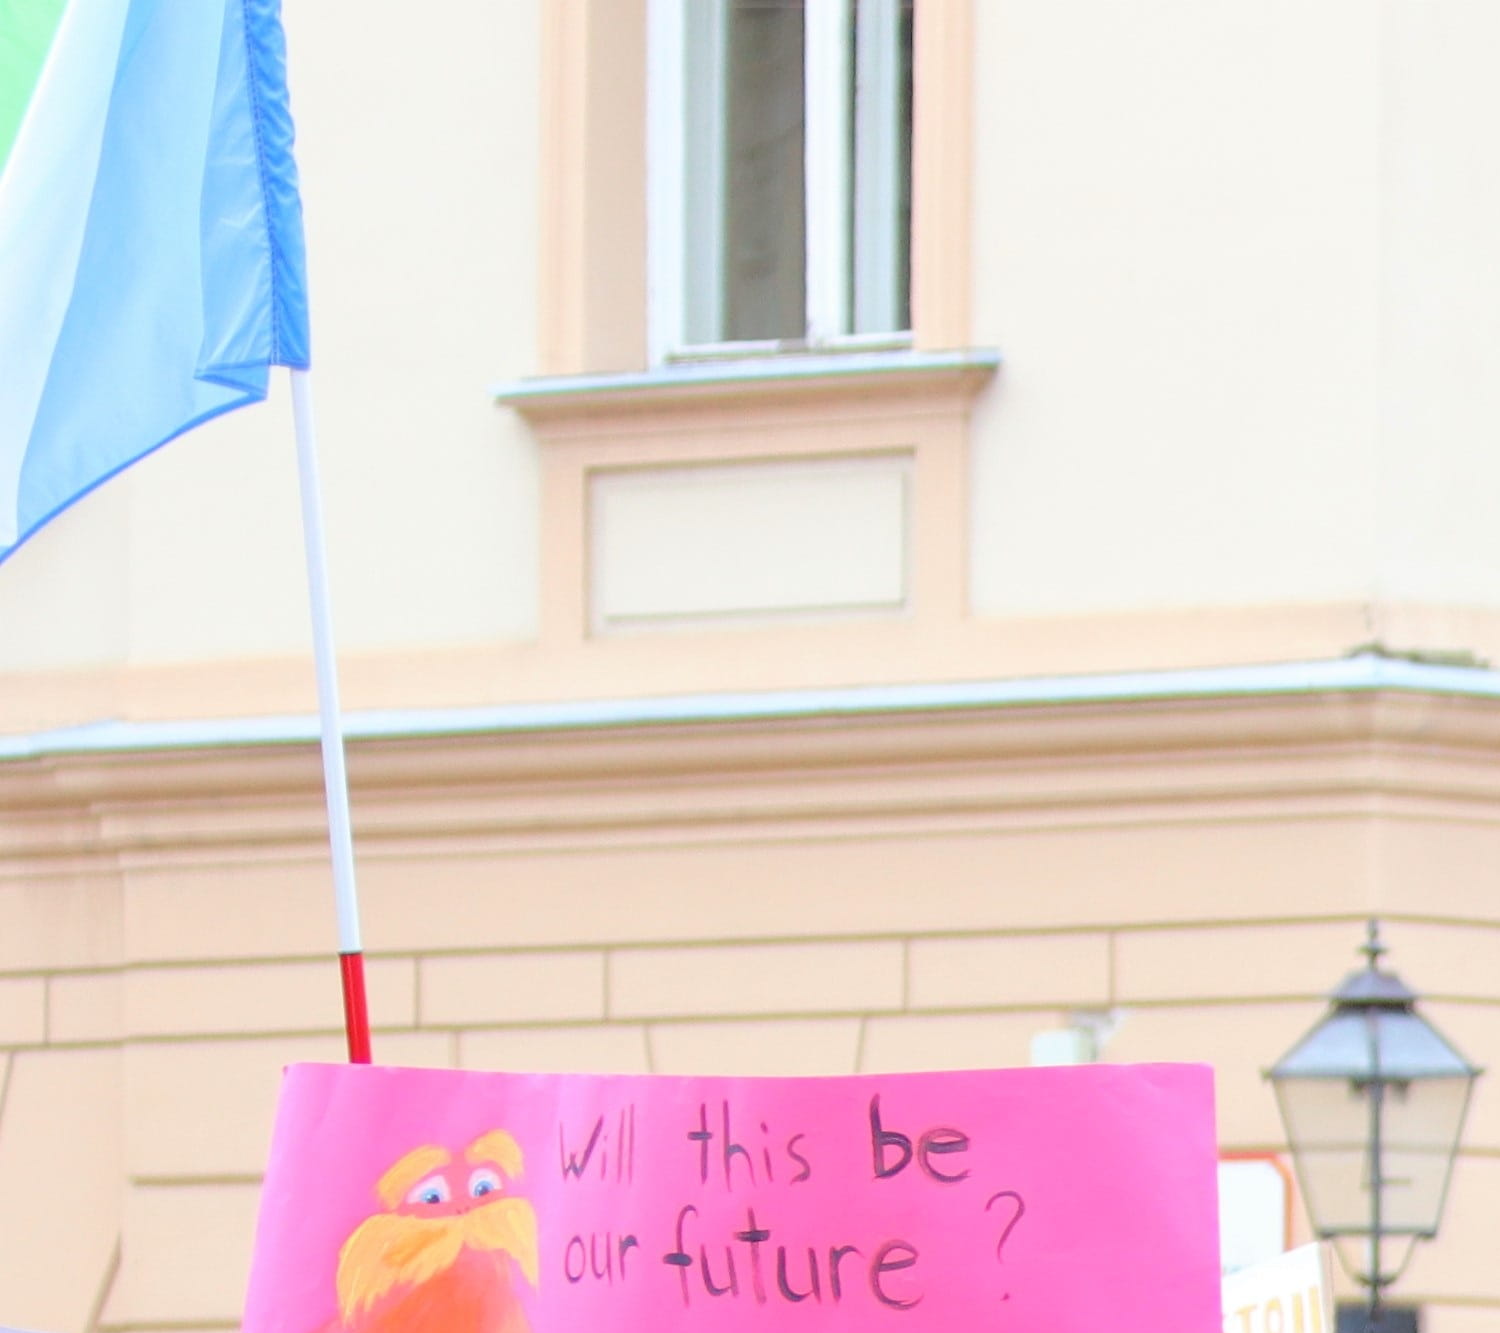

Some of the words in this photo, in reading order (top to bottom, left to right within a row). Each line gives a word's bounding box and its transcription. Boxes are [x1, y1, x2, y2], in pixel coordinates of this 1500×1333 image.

[559, 1119, 637, 1184] Will
[686, 1100, 812, 1189] this
[870, 1092, 973, 1184] be
[564, 1227, 639, 1286] our
[661, 1202, 927, 1311] future
